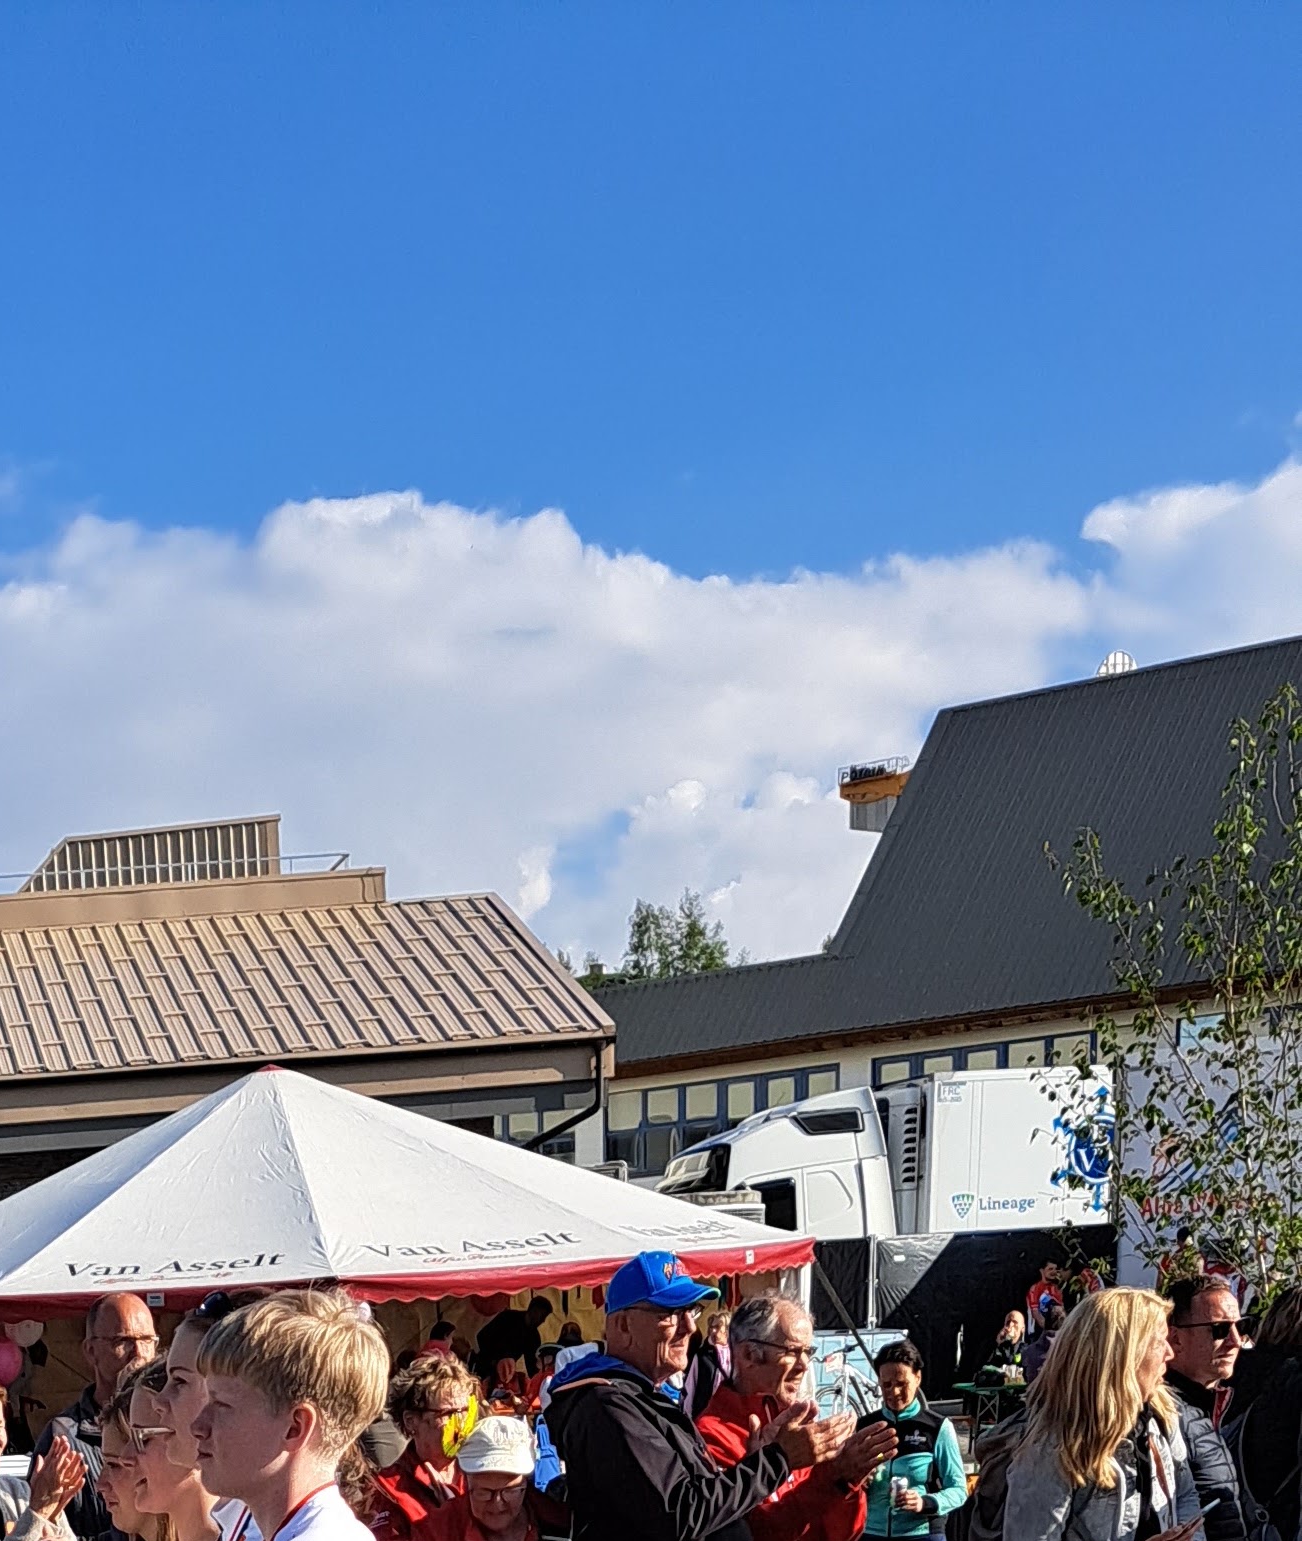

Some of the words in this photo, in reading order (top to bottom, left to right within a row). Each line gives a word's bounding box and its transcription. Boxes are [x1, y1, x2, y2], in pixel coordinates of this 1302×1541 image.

[979, 1196, 1035, 1214] Lineage
[360, 1243, 451, 1258] Van
[461, 1230, 582, 1253] Asselt
[65, 1262, 141, 1277] Van
[152, 1253, 286, 1274] Asselt
